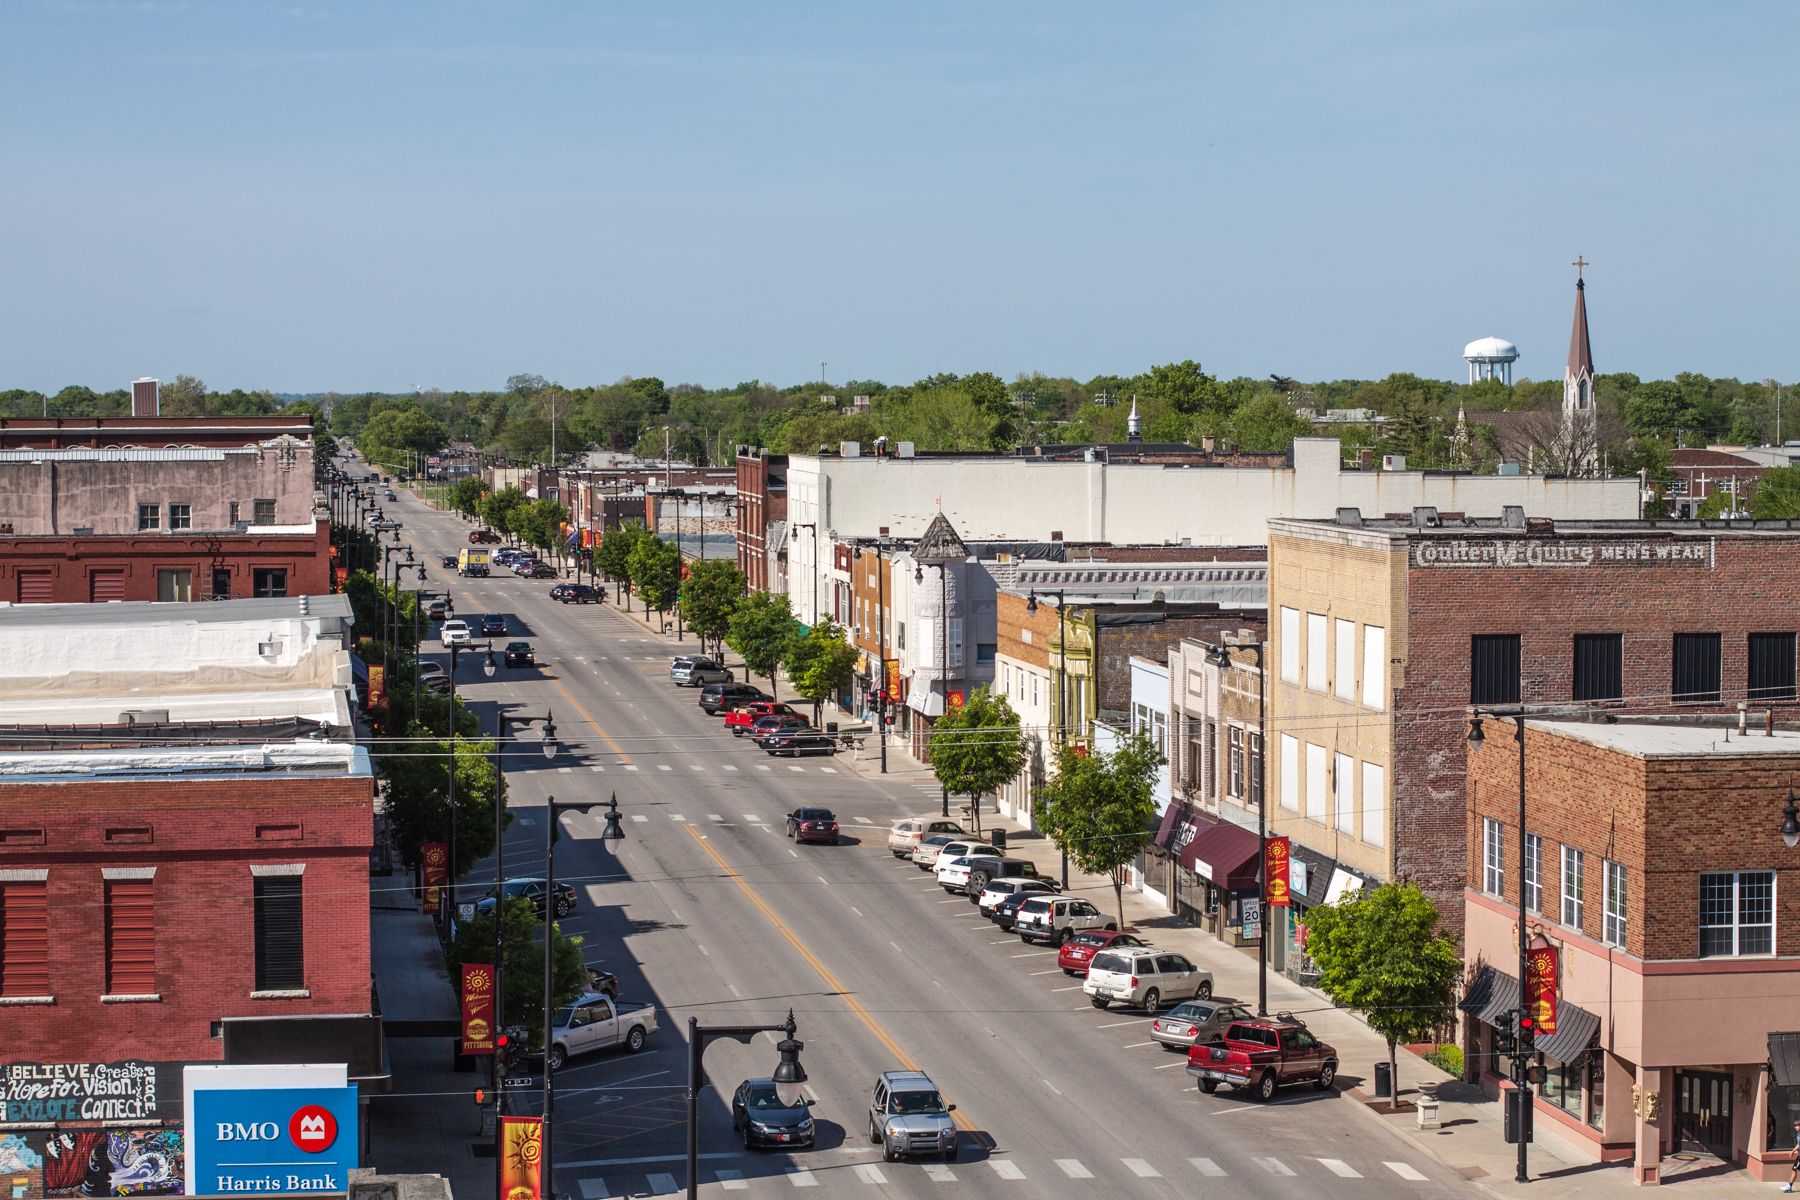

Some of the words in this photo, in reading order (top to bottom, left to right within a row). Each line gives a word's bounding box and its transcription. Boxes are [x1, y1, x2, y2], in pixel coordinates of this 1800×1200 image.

[1601, 544, 1650, 560] MEN'S
[1655, 545, 1705, 560] WEAR
[1244, 911, 1259, 921] 20
[464, 1041, 494, 1050] PITTSBURG
[12, 1063, 95, 1080] BELIEVE.
[216, 1122, 280, 1141] BMO
[217, 1175, 281, 1191] Harris
[286, 1174, 338, 1190] Bank
